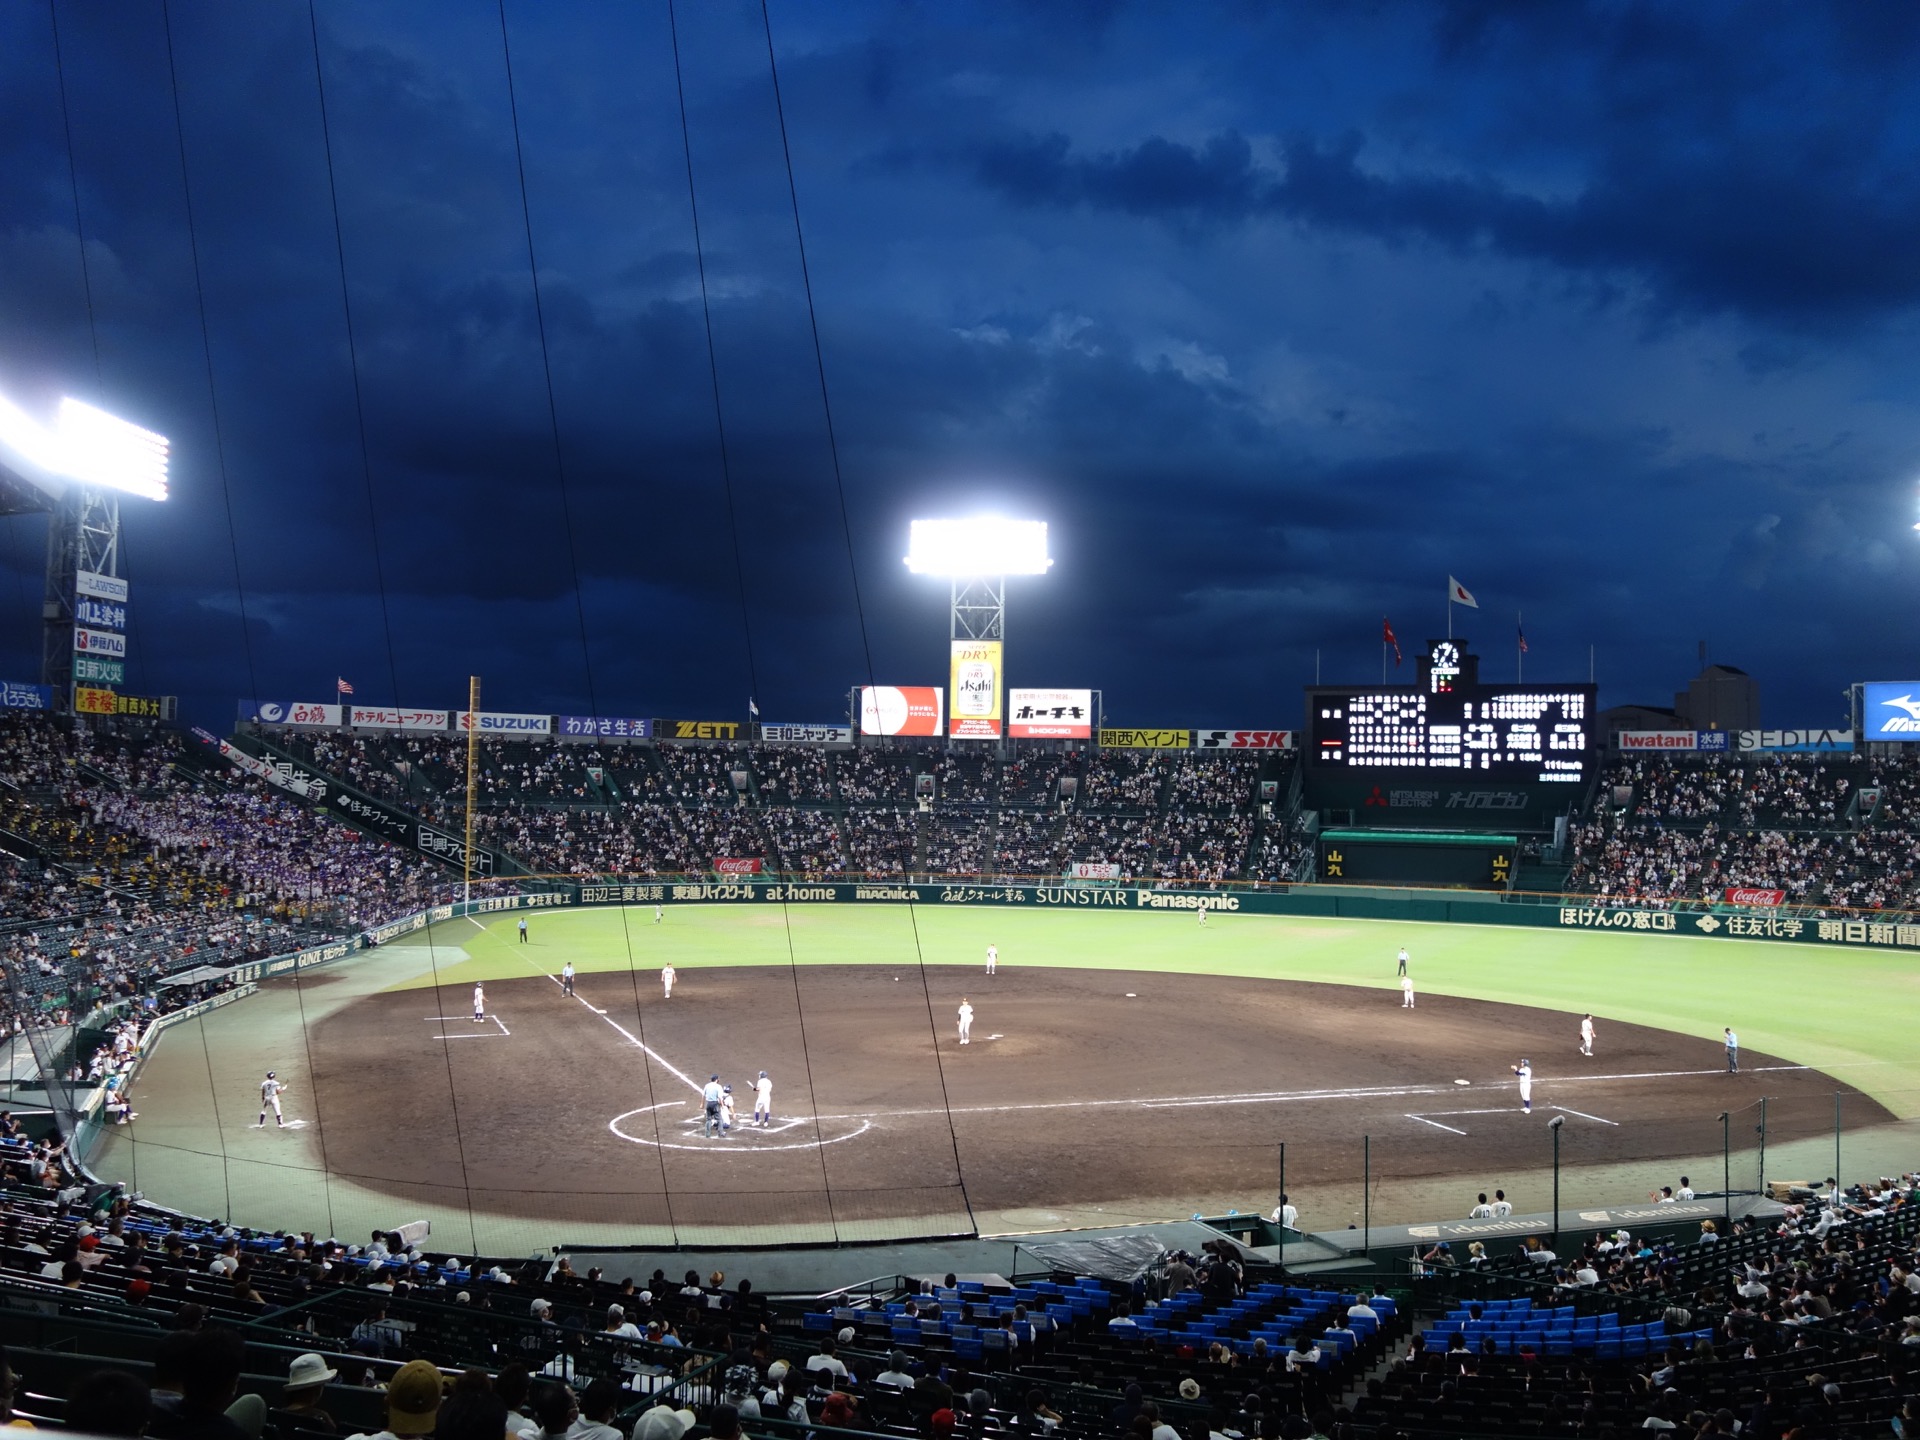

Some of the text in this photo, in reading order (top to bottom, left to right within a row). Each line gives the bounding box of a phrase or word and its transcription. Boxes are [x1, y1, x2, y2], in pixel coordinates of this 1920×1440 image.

[78, 602, 125, 628] 川上塗料
[76, 660, 122, 682] 日新火災
[960, 679, 991, 692] Asahi
[9, 690, 43, 708] ろうきん
[293, 705, 326, 724] 白鶴
[353, 711, 445, 726] ホテルニューアワジ
[1016, 705, 1084, 719] ホーチキ
[480, 716, 547, 730] SUZUKI
[566, 717, 645, 737] わかさ生活
[675, 721, 739, 739] ZETT
[1101, 731, 1188, 746] 関西ペイント
[1231, 731, 1288, 748] SSK
[1623, 733, 1693, 748] Iwatani
[1701, 732, 1724, 744] 水素
[1390, 790, 1439, 799] MITSUBISHI
[1390, 799, 1433, 808] ELECTRIC
[351, 801, 408, 834] 住友ファーマ
[537, 893, 571, 906] 住友電工
[582, 886, 664, 903] 田辺三菱製薬
[673, 885, 755, 900] 東進ハイスクール
[785, 883, 836, 900] home
[1036, 888, 1128, 906] SUNSTAR
[1137, 890, 1240, 910] Panasonic
[1560, 907, 1668, 930] ほけんの窓口
[1725, 916, 1803, 938] 住友化学
[1818, 921, 1920, 946] 朝日新聞
[298, 949, 322, 967] GUNZE
[1611, 1205, 1711, 1219] idemitsu
[1443, 1219, 1549, 1234] idemitsu
